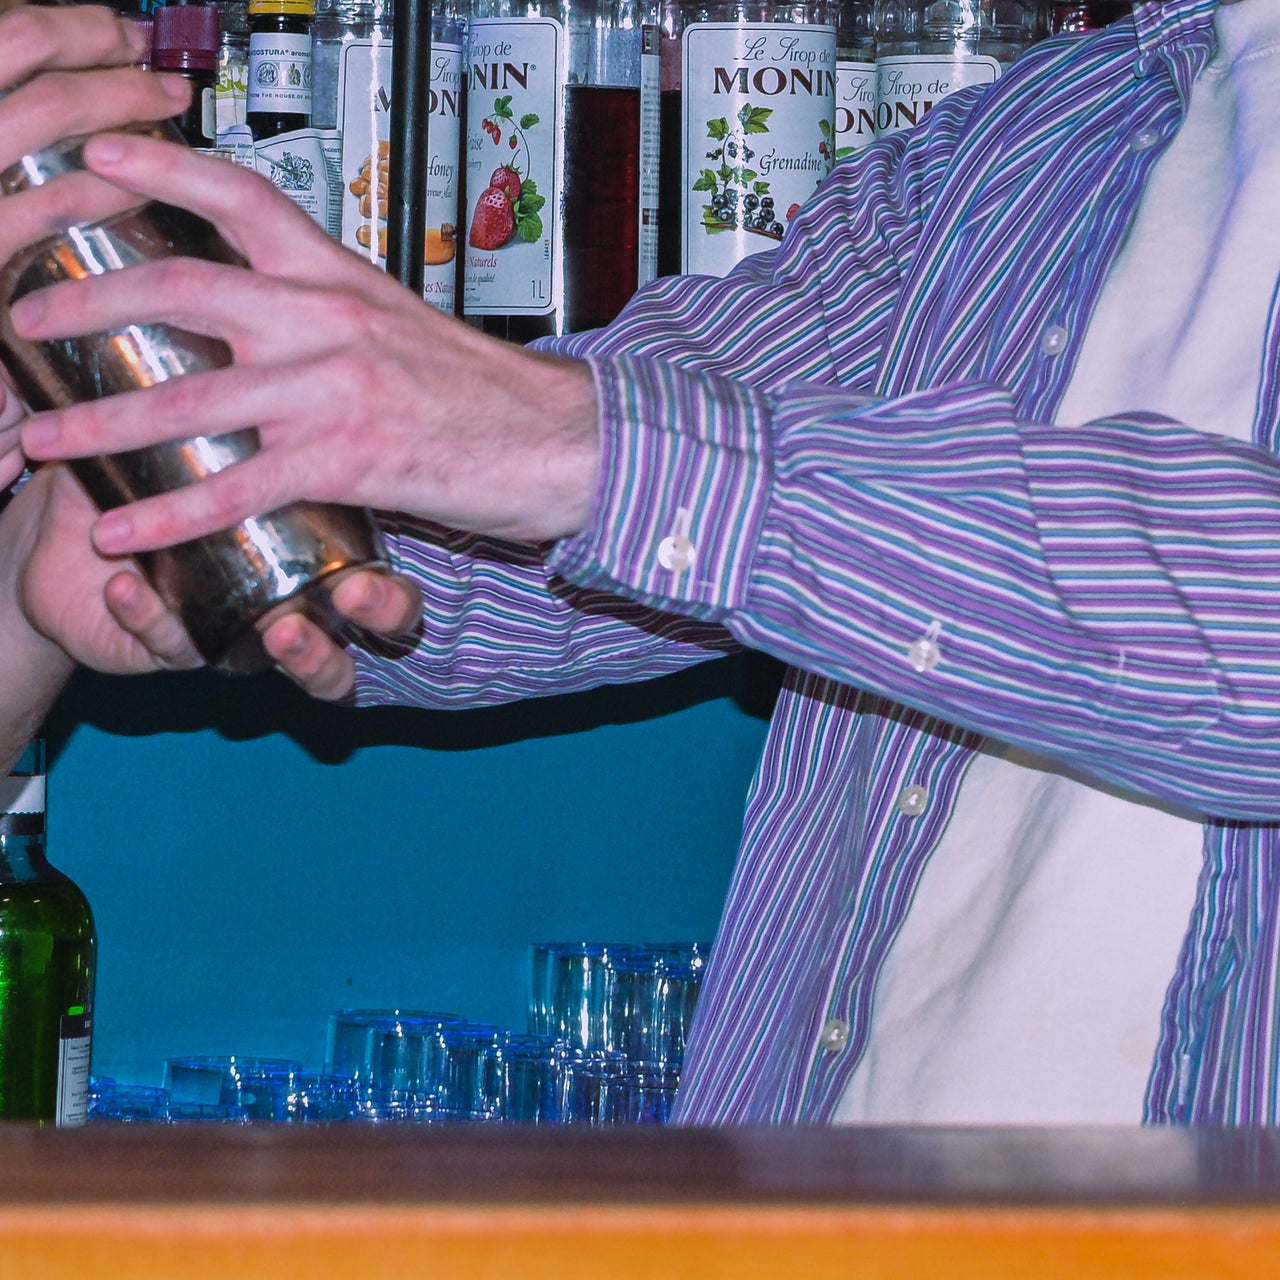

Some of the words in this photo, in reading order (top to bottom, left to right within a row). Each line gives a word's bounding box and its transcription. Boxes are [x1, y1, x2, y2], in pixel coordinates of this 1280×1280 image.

[495, 44, 512, 57] de
[733, 36, 767, 61] Le
[771, 36, 816, 67] Sirop
[818, 48, 830, 61] de
[884, 70, 921, 101] Sirop
[928, 78, 949, 94] de
[759, 148, 822, 177] Grenadine
